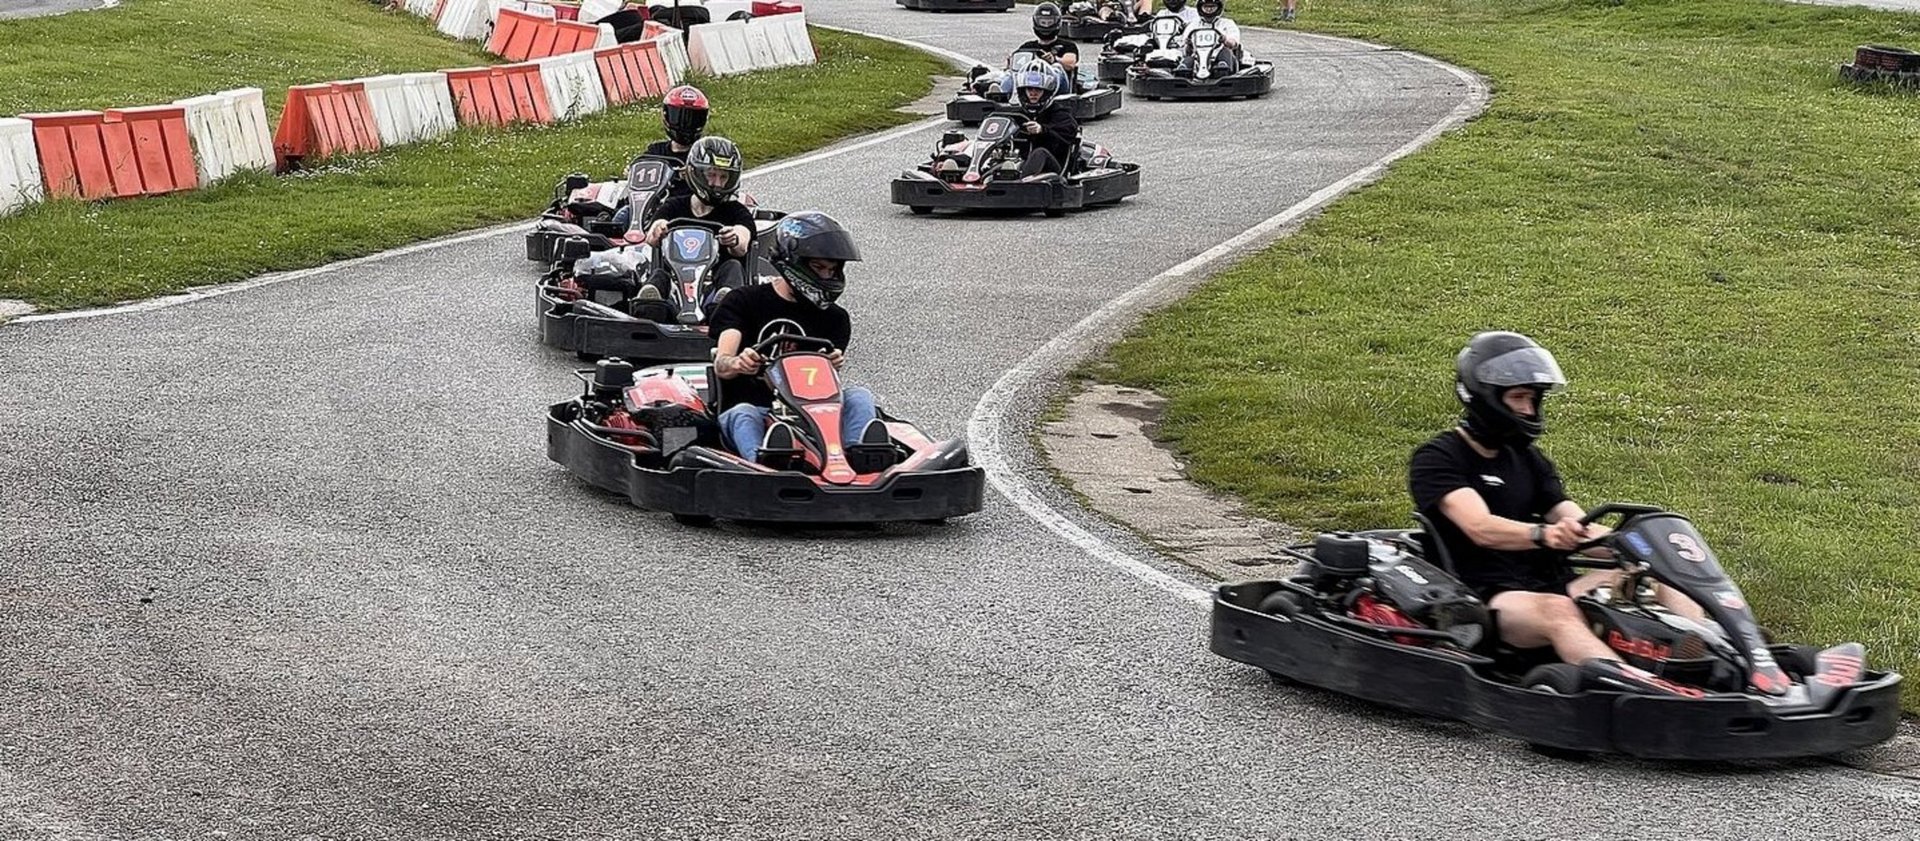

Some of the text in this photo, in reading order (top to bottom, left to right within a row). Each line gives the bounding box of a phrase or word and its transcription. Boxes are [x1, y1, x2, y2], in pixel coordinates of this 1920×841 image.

[1198, 34, 1213, 42] 10
[636, 168, 657, 182] 11
[683, 236, 700, 253] 9
[800, 367, 817, 386] 7
[1668, 532, 1706, 563] 3
[1609, 630, 1638, 656] Red
